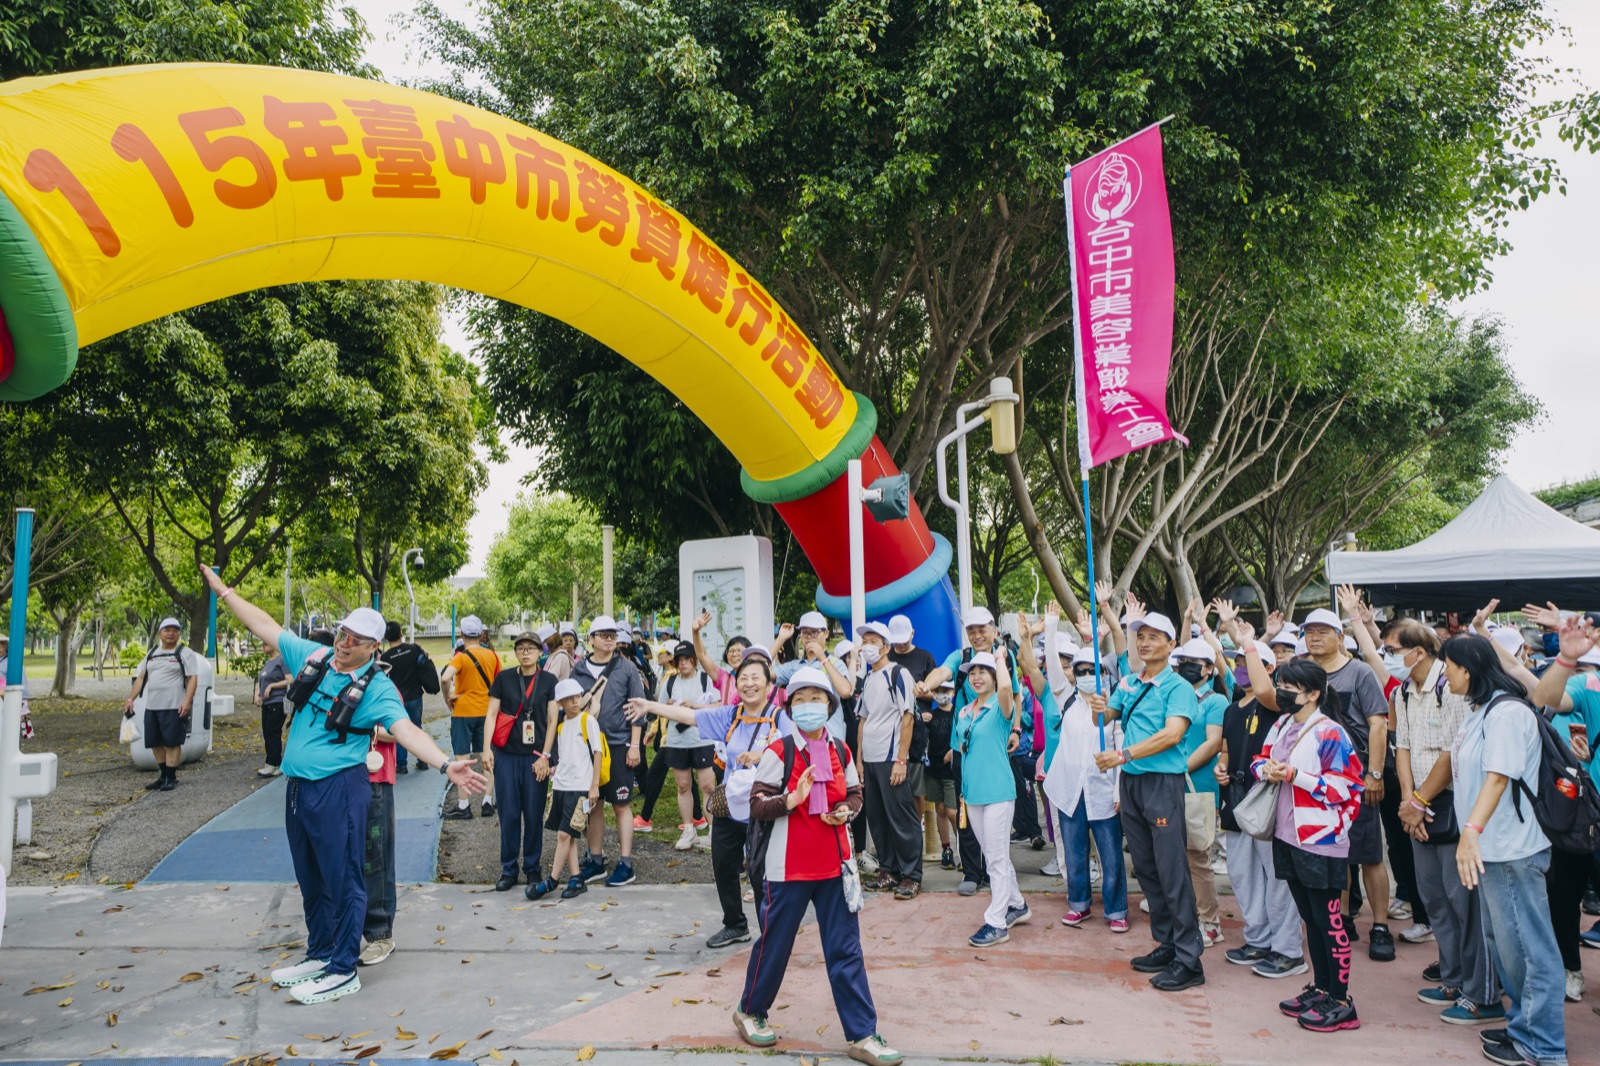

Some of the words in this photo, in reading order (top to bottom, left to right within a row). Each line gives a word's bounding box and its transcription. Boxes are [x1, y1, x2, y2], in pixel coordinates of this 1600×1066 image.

[23, 95, 845, 430] 115年臺中市勞資健行活動
[1328, 898, 1351, 984] adidas
